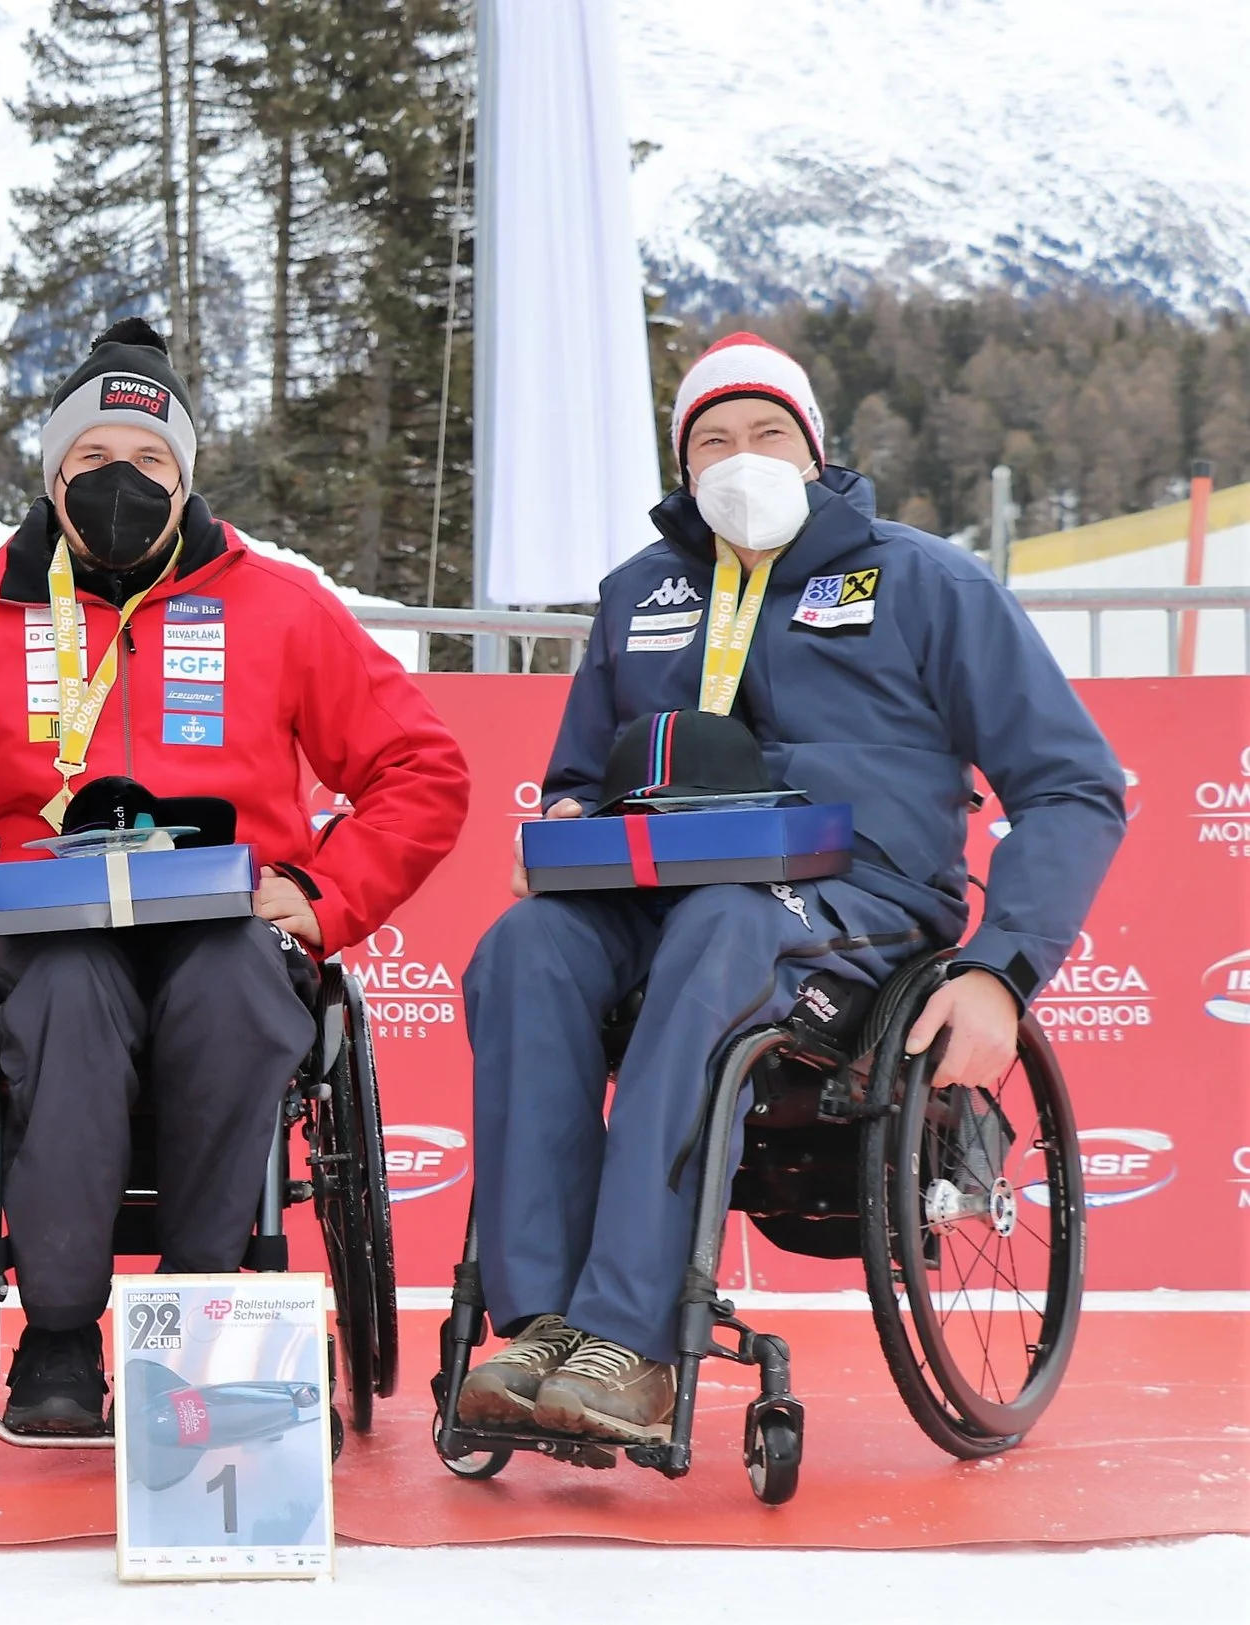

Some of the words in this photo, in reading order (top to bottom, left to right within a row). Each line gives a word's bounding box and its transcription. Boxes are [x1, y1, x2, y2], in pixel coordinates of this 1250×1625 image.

[105, 391, 161, 413] sliding
[168, 601, 199, 613] Julius
[201, 604, 222, 614] Bär
[57, 596, 74, 652] BOBRUN
[710, 592, 734, 649] BOBRUN
[730, 595, 760, 650] BOBRUN
[167, 628, 221, 639] SILVAPLANA
[72, 680, 108, 734] BOBRUN
[352, 962, 455, 989] MEGA
[1049, 965, 1149, 992] MEGA
[367, 1003, 455, 1023] NOBOB
[1035, 1005, 1151, 1027] ONOBOB
[378, 1026, 427, 1039] RIES
[1043, 1029, 1124, 1042] SERIES
[128, 1293, 180, 1302] ENGIADINA
[235, 1299, 316, 1310] Rollstuhlsport
[128, 1303, 181, 1349] 92
[233, 1310, 282, 1320] Schweiz
[146, 1337, 181, 1349] CLUB
[206, 1464, 238, 1534] 1
